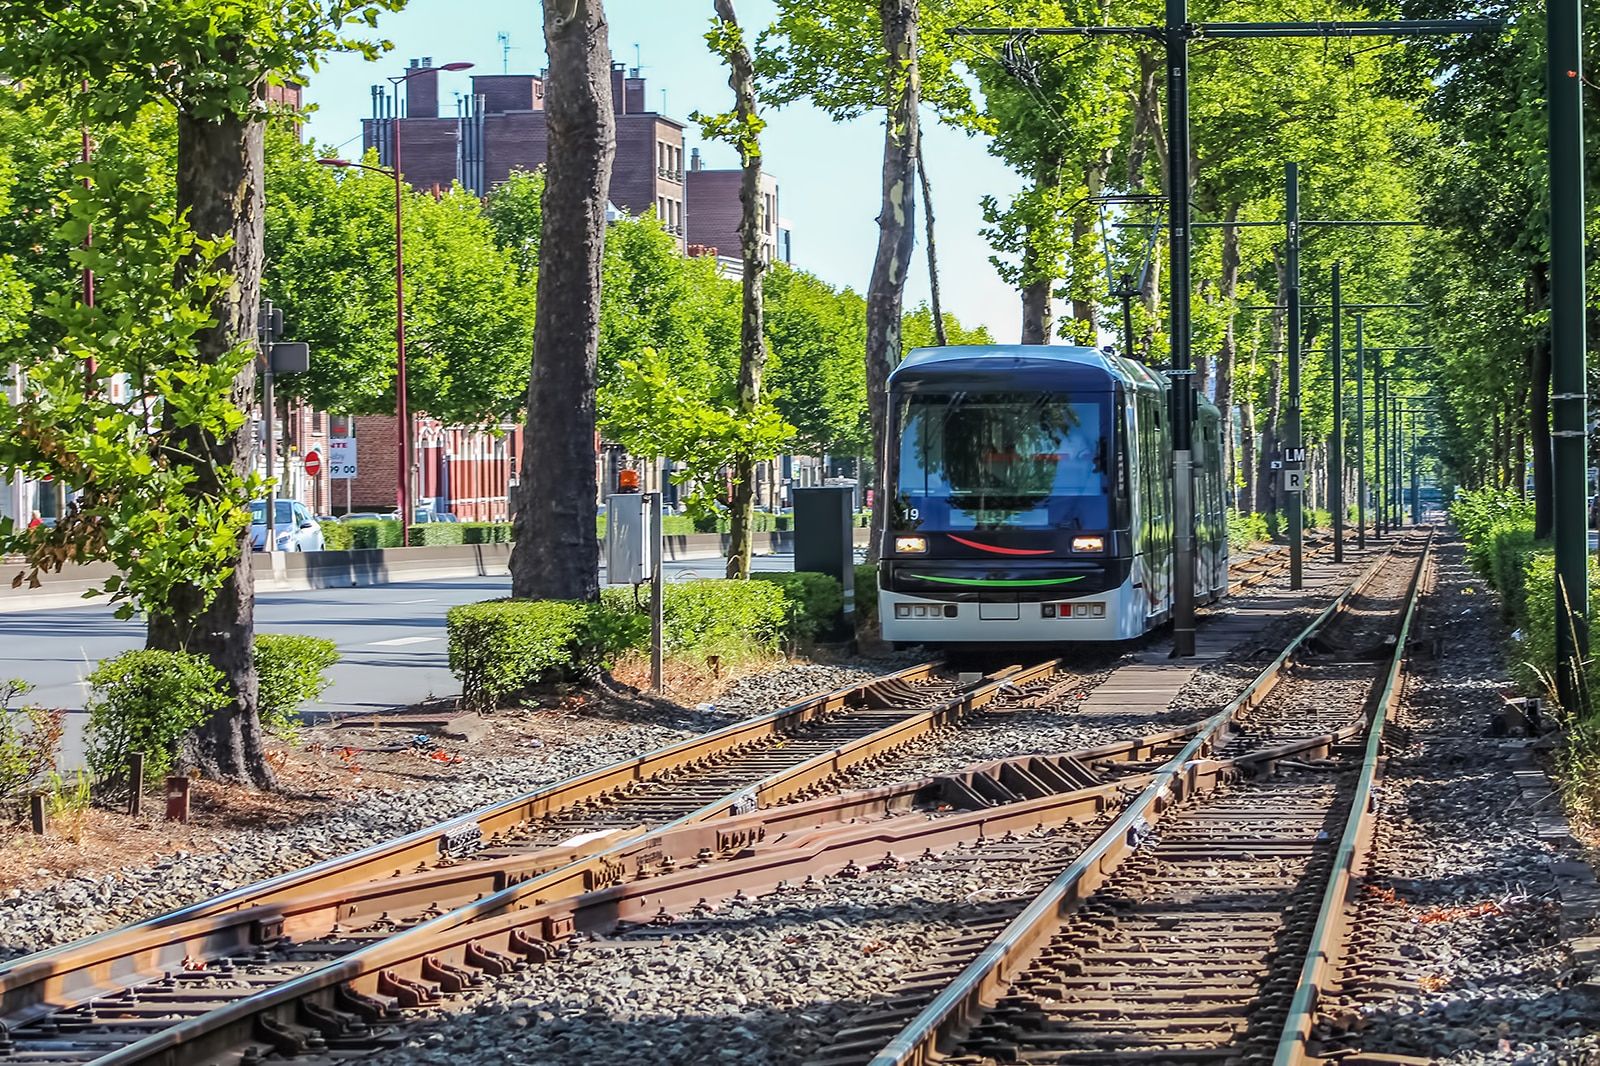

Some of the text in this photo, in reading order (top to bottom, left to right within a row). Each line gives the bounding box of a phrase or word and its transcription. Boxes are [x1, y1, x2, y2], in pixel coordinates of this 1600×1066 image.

[1285, 449, 1305, 461] LM
[1290, 474, 1299, 486] R
[902, 508, 919, 520] 19
